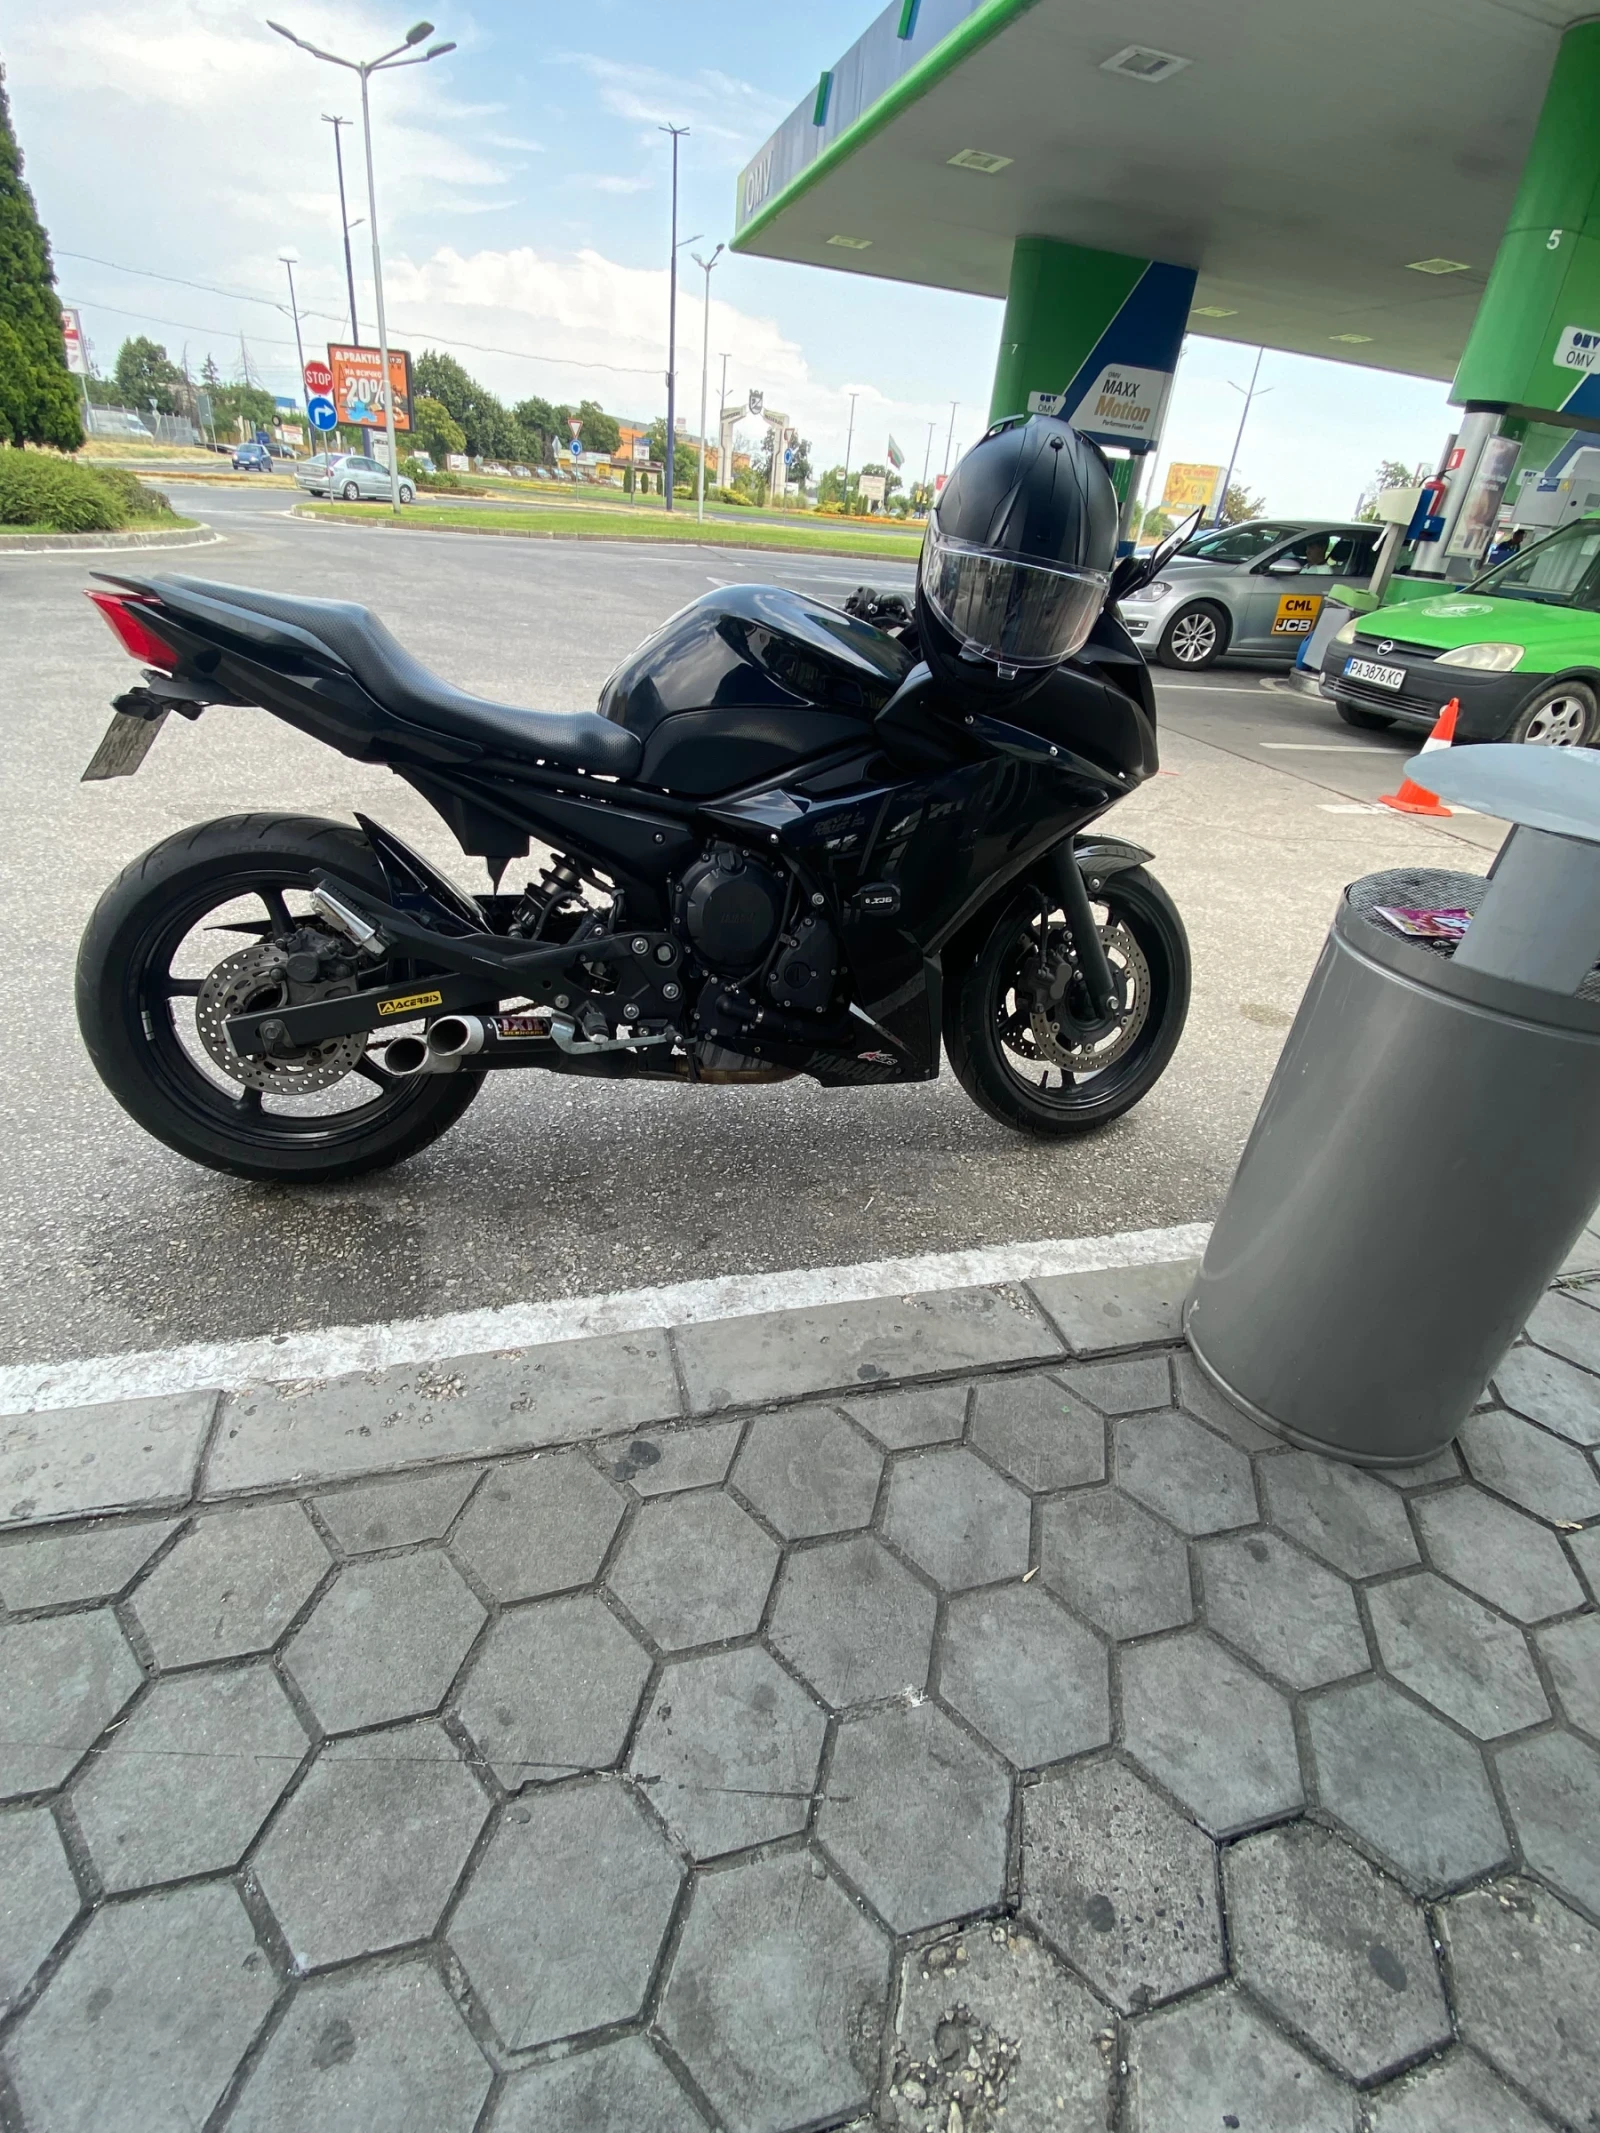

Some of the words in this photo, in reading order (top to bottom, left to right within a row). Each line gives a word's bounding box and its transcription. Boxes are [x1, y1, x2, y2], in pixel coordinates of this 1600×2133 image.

[746, 150, 774, 213] OMV
[1546, 229, 1563, 250] 5
[1011, 344, 1019, 355] 7
[342, 351, 381, 365] PRAKTIS
[1566, 350, 1595, 368] OMV
[306, 370, 332, 386] STOP
[1102, 379, 1141, 398] MAXX
[1037, 404, 1056, 413] OMV
[1094, 395, 1151, 423] Motion
[1102, 419, 1131, 429] Performance
[1143, 441, 1150, 449] 7
[1285, 600, 1313, 611] CML
[1275, 619, 1312, 632] JCB
[395, 994, 440, 1010] ACERBIS
[804, 1049, 894, 1083] YAMAHA
